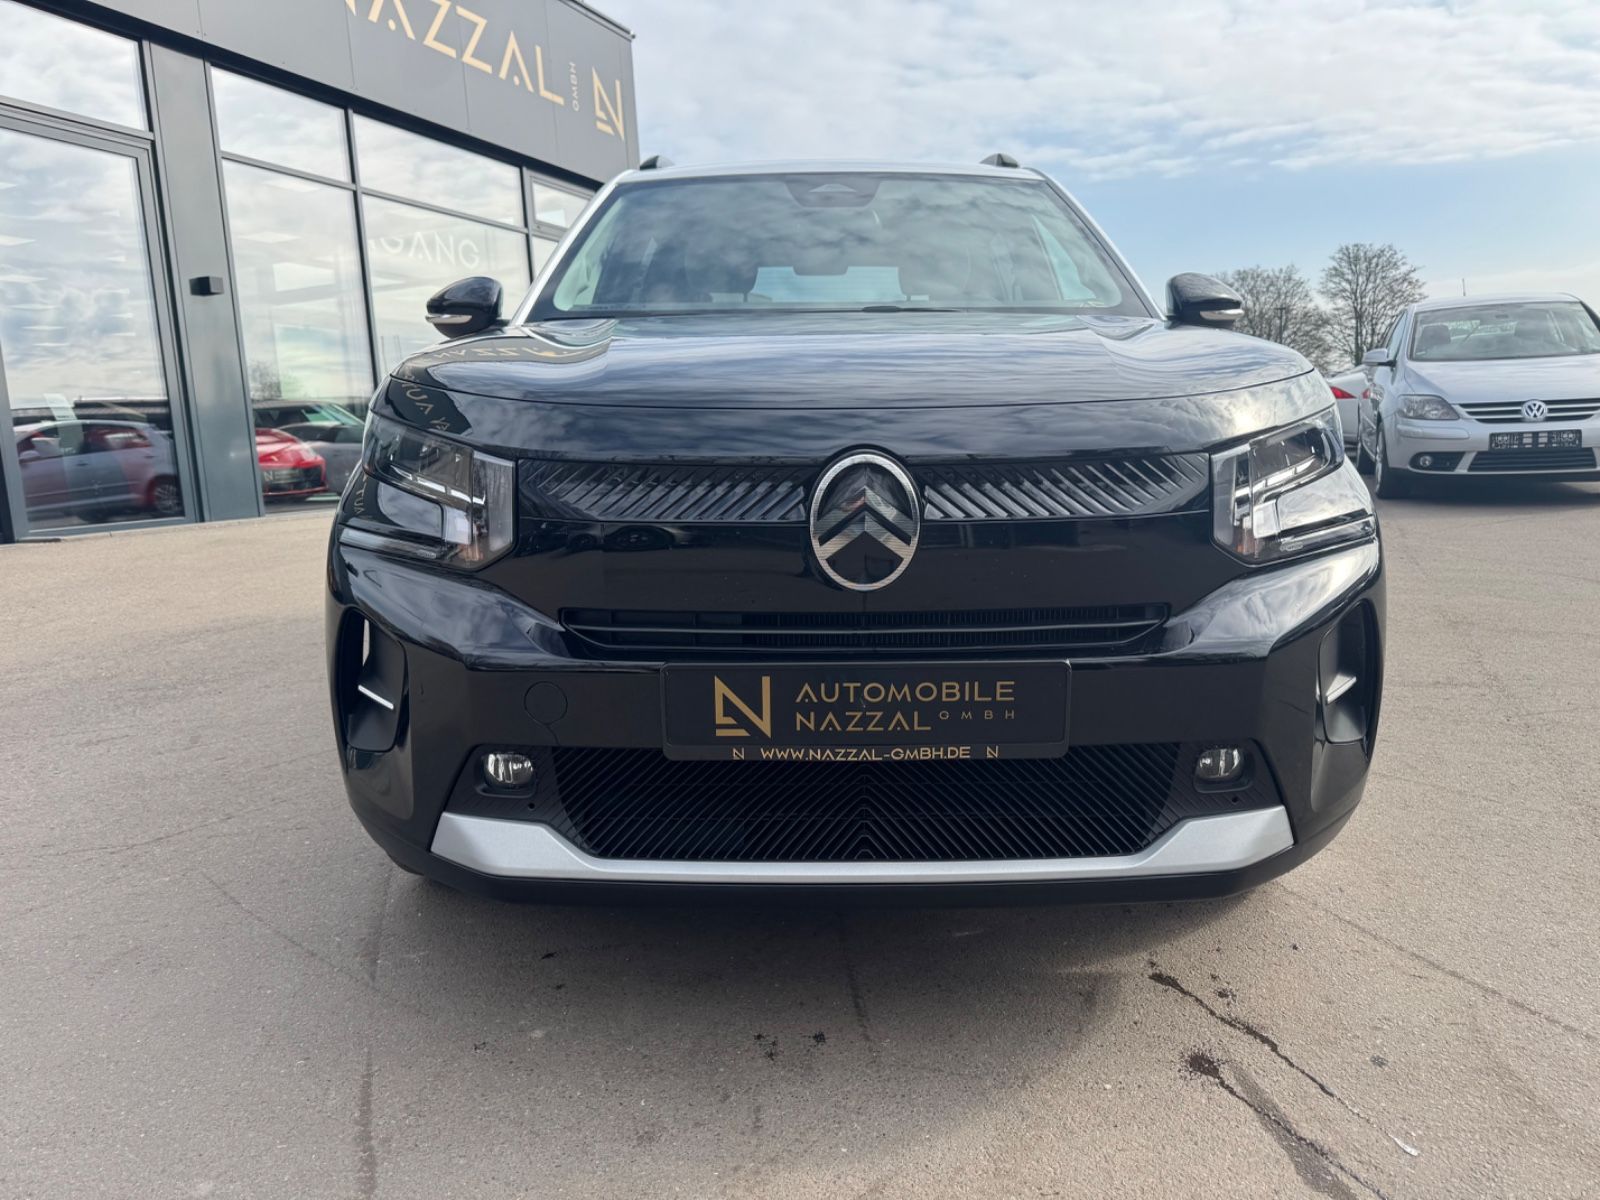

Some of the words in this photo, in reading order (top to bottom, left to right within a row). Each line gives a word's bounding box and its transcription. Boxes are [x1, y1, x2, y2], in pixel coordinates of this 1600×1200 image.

[345, 0, 564, 106] AZZAL
[368, 231, 480, 269] GANG
[795, 681, 1015, 703] AUTOMOBILE
[796, 711, 932, 731] NAZZAL
[760, 746, 971, 761] WWW.NAZZAL-GMBH.DE
